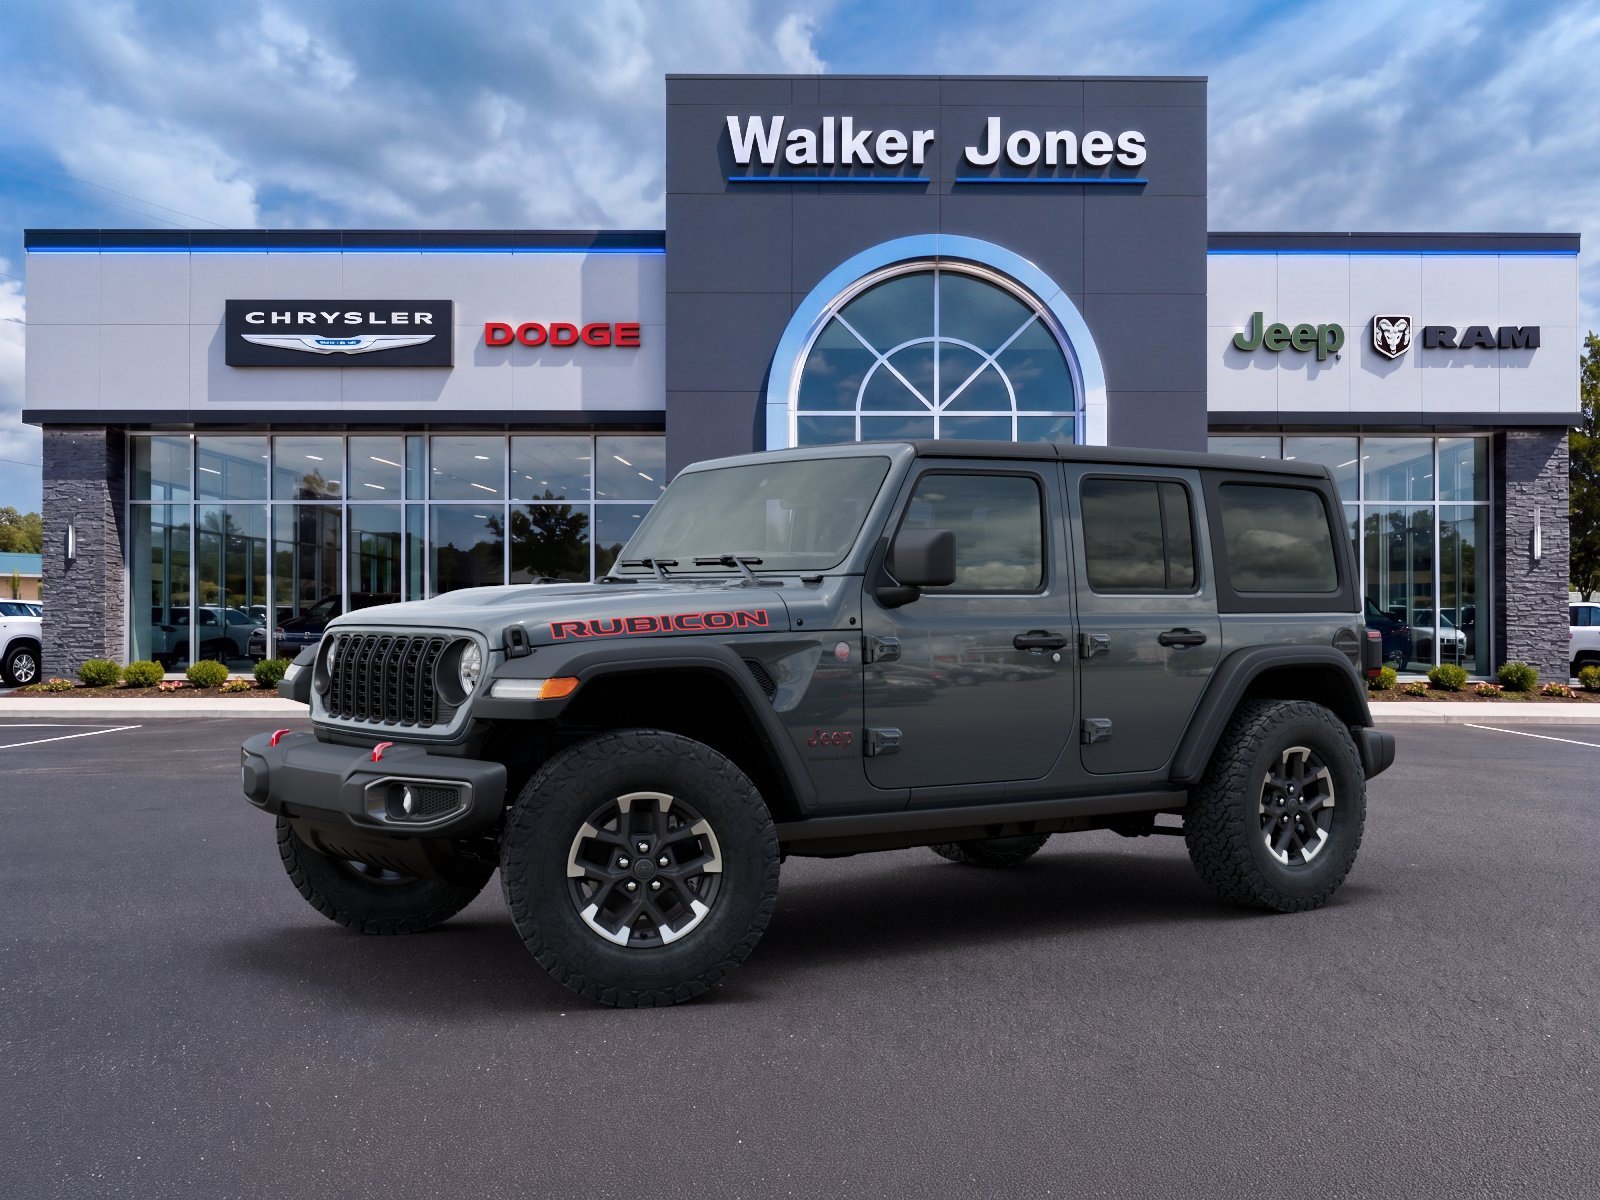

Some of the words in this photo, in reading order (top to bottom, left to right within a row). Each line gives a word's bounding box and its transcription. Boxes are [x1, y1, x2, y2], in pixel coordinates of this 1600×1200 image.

[725, 115, 935, 165] Walker
[964, 116, 1148, 167] Jones
[245, 311, 434, 325] CHRYSLER
[485, 322, 641, 348] DODGE
[1233, 311, 1345, 361] Jeep
[1423, 325, 1541, 349] RAM
[550, 609, 769, 640] RUBICON
[807, 728, 853, 752] Jeep
